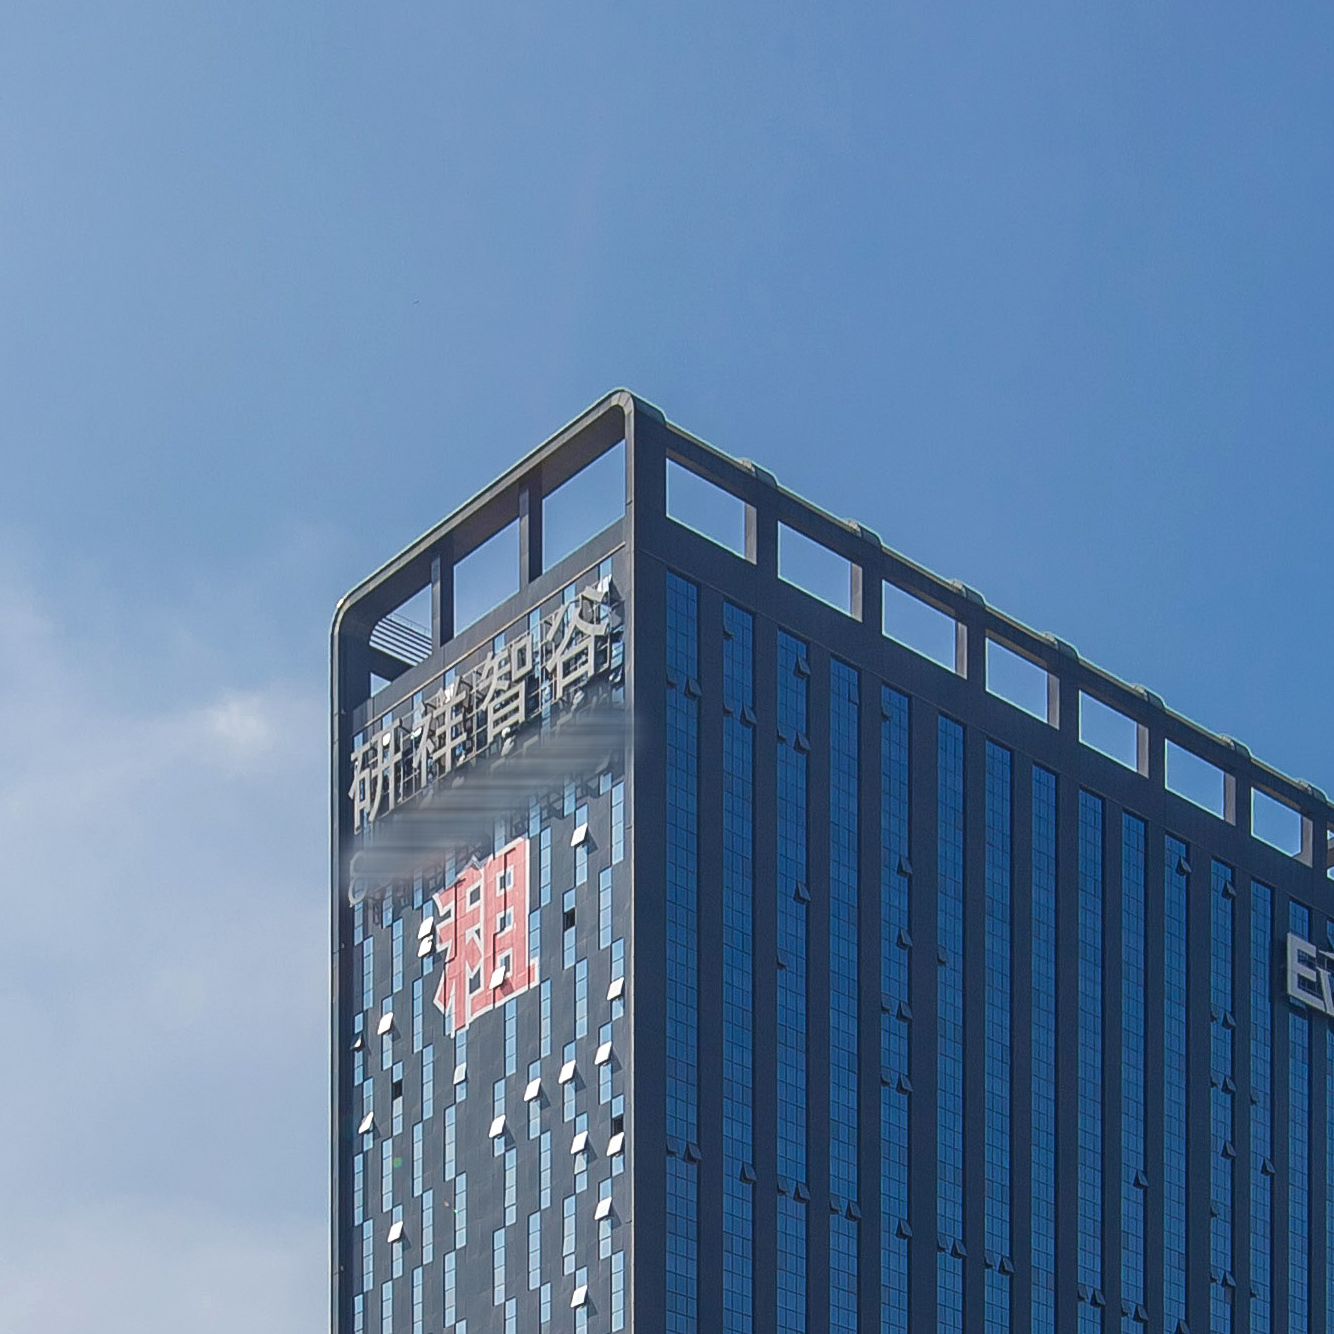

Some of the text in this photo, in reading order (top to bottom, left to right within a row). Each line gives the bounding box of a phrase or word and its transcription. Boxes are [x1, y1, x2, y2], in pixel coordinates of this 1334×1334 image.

[348, 576, 613, 834] 研祥智谷
[432, 835, 540, 1038] 租
